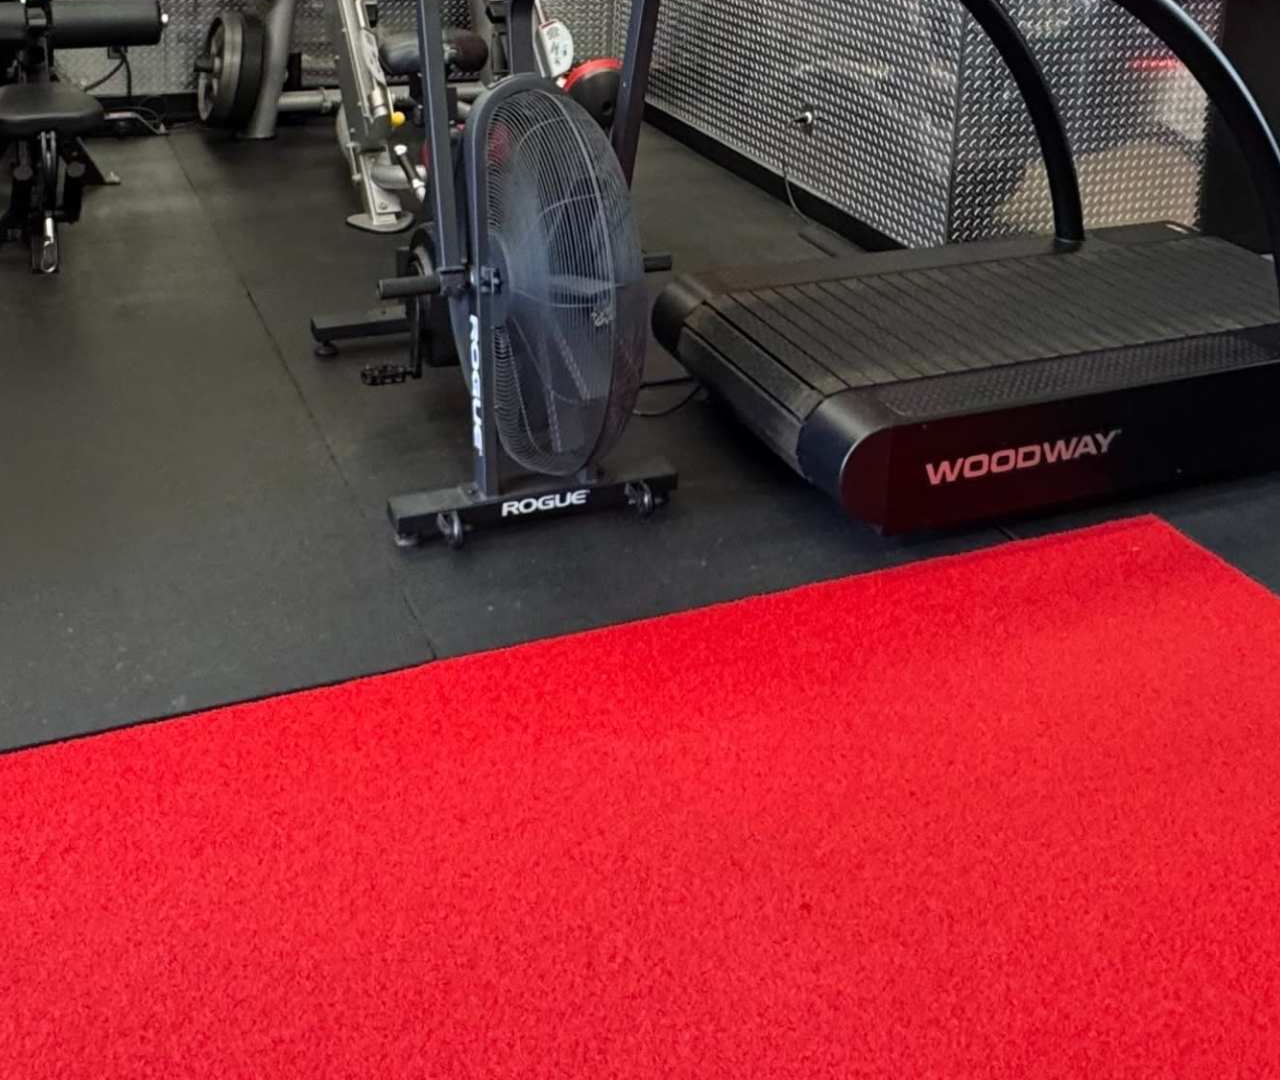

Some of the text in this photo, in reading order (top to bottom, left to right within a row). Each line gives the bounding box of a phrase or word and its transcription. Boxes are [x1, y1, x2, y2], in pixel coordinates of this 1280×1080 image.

[469, 315, 484, 456] ROGUE
[925, 430, 1118, 486] WOODWAY
[501, 490, 588, 517] ROGUE
